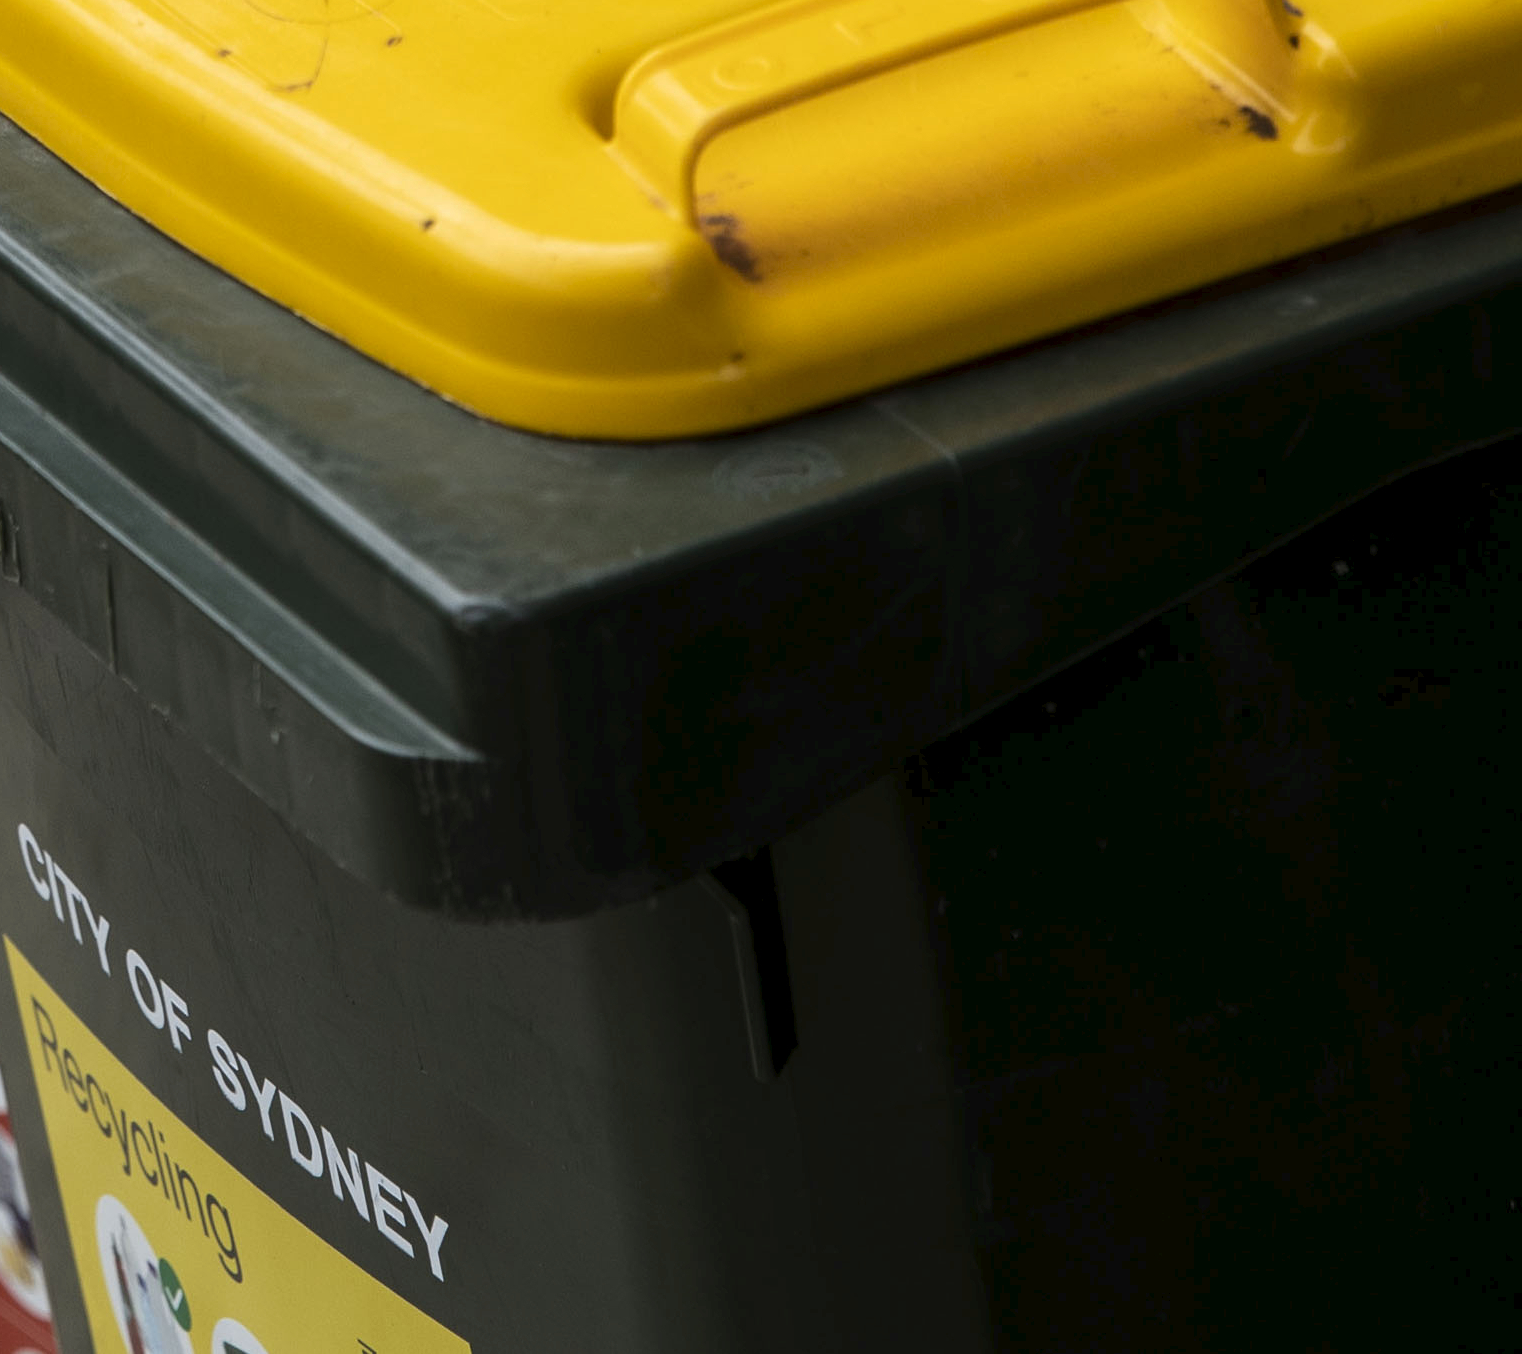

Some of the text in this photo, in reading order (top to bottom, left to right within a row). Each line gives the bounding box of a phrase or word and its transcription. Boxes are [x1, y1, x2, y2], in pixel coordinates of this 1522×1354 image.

[18, 823, 449, 1283] CITY OF SYDNEY
[32, 994, 244, 1284] Recycling
